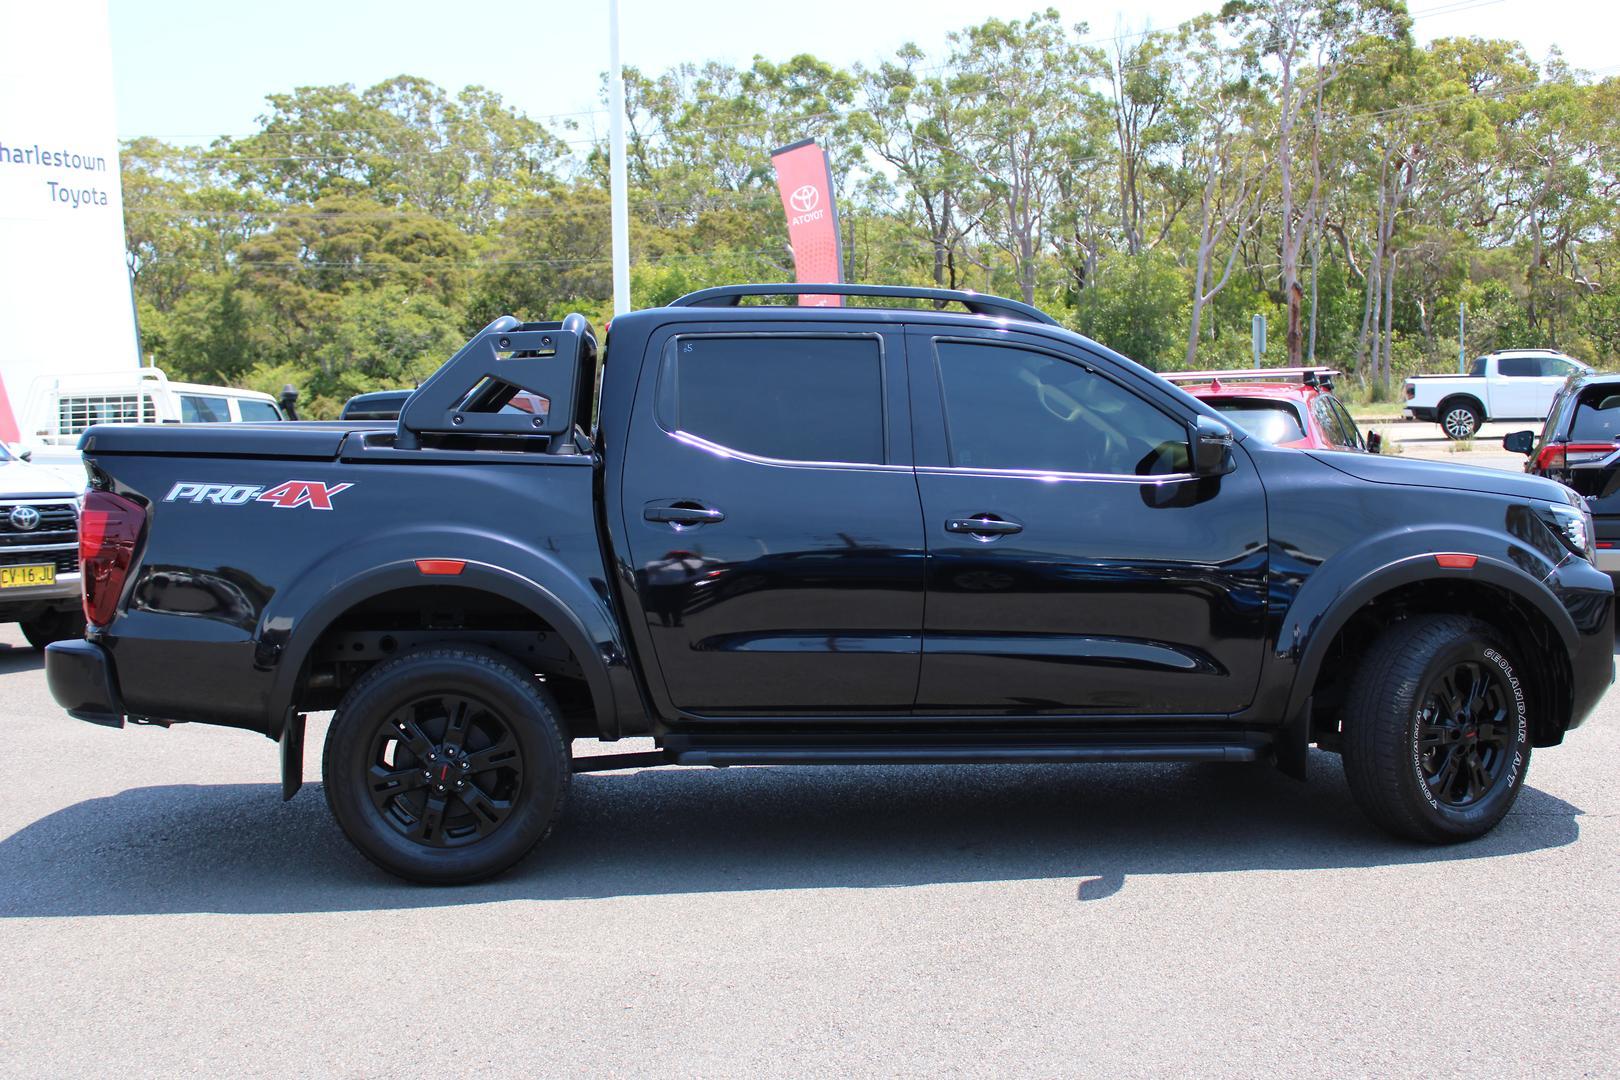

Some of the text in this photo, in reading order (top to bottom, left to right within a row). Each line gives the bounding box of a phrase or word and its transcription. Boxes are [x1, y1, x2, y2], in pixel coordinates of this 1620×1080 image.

[47, 181, 108, 209] Toyota
[162, 480, 355, 510] PRO-4X
[1483, 648, 1527, 743] GEOLANDAR
